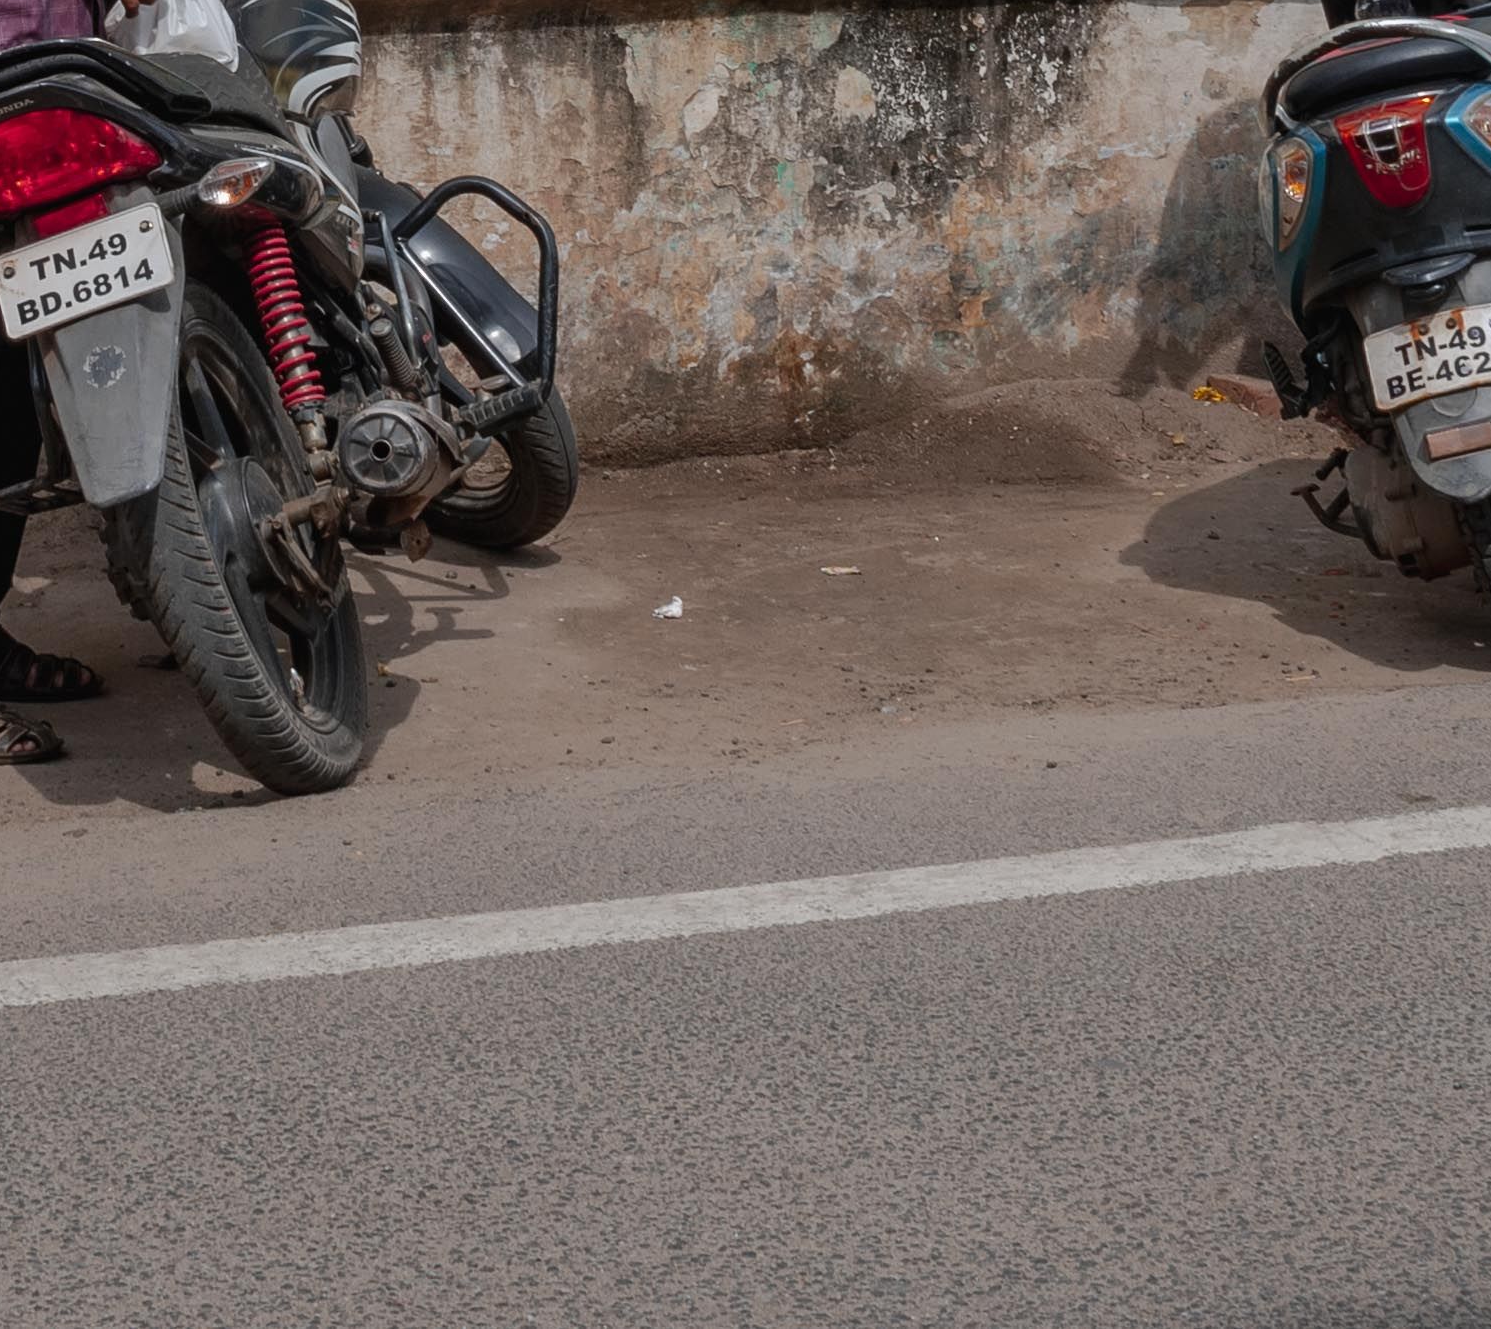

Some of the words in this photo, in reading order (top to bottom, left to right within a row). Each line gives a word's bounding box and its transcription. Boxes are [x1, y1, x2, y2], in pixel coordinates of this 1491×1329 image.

[28, 232, 129, 282] TN.49
[16, 258, 155, 326] BD.6814
[1394, 325, 1486, 367] TN-49
